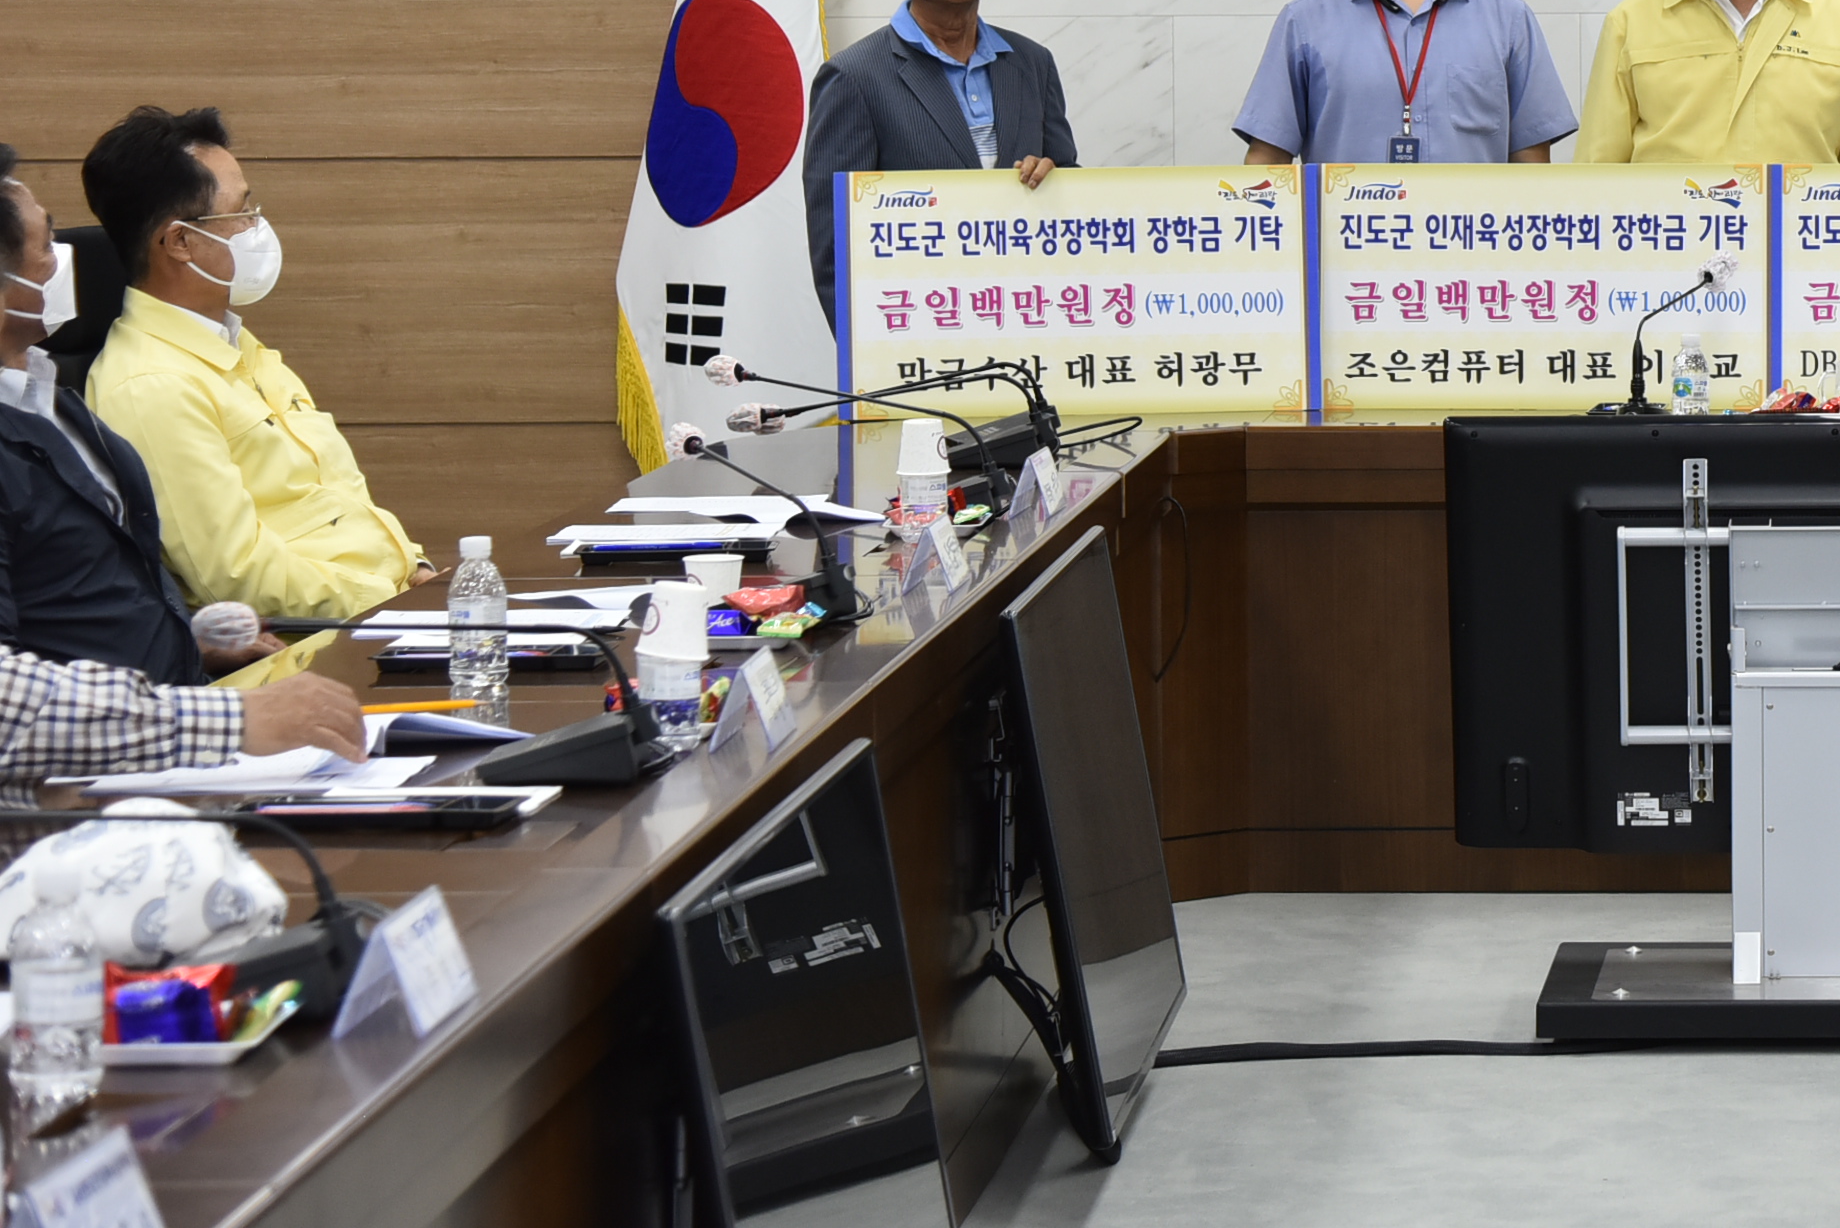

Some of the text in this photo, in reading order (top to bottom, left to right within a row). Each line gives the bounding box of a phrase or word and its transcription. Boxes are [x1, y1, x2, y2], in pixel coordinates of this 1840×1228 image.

[873, 192, 926, 209] Jindo
[1344, 186, 1396, 202] Jindo
[870, 216, 1283, 258] 진도군 인재육성장학회 장학금 기탁
[1341, 213, 1748, 251] 진도군 인재육성장학회 장학금 기탁
[877, 283, 1135, 329] 금일백만원정
[1345, 279, 1598, 322] 금일백만원정
[1063, 353, 1135, 389] 대표
[1152, 351, 1261, 387] 허광무
[1343, 348, 1742, 384] 조은컴퓨터 대표 이교
